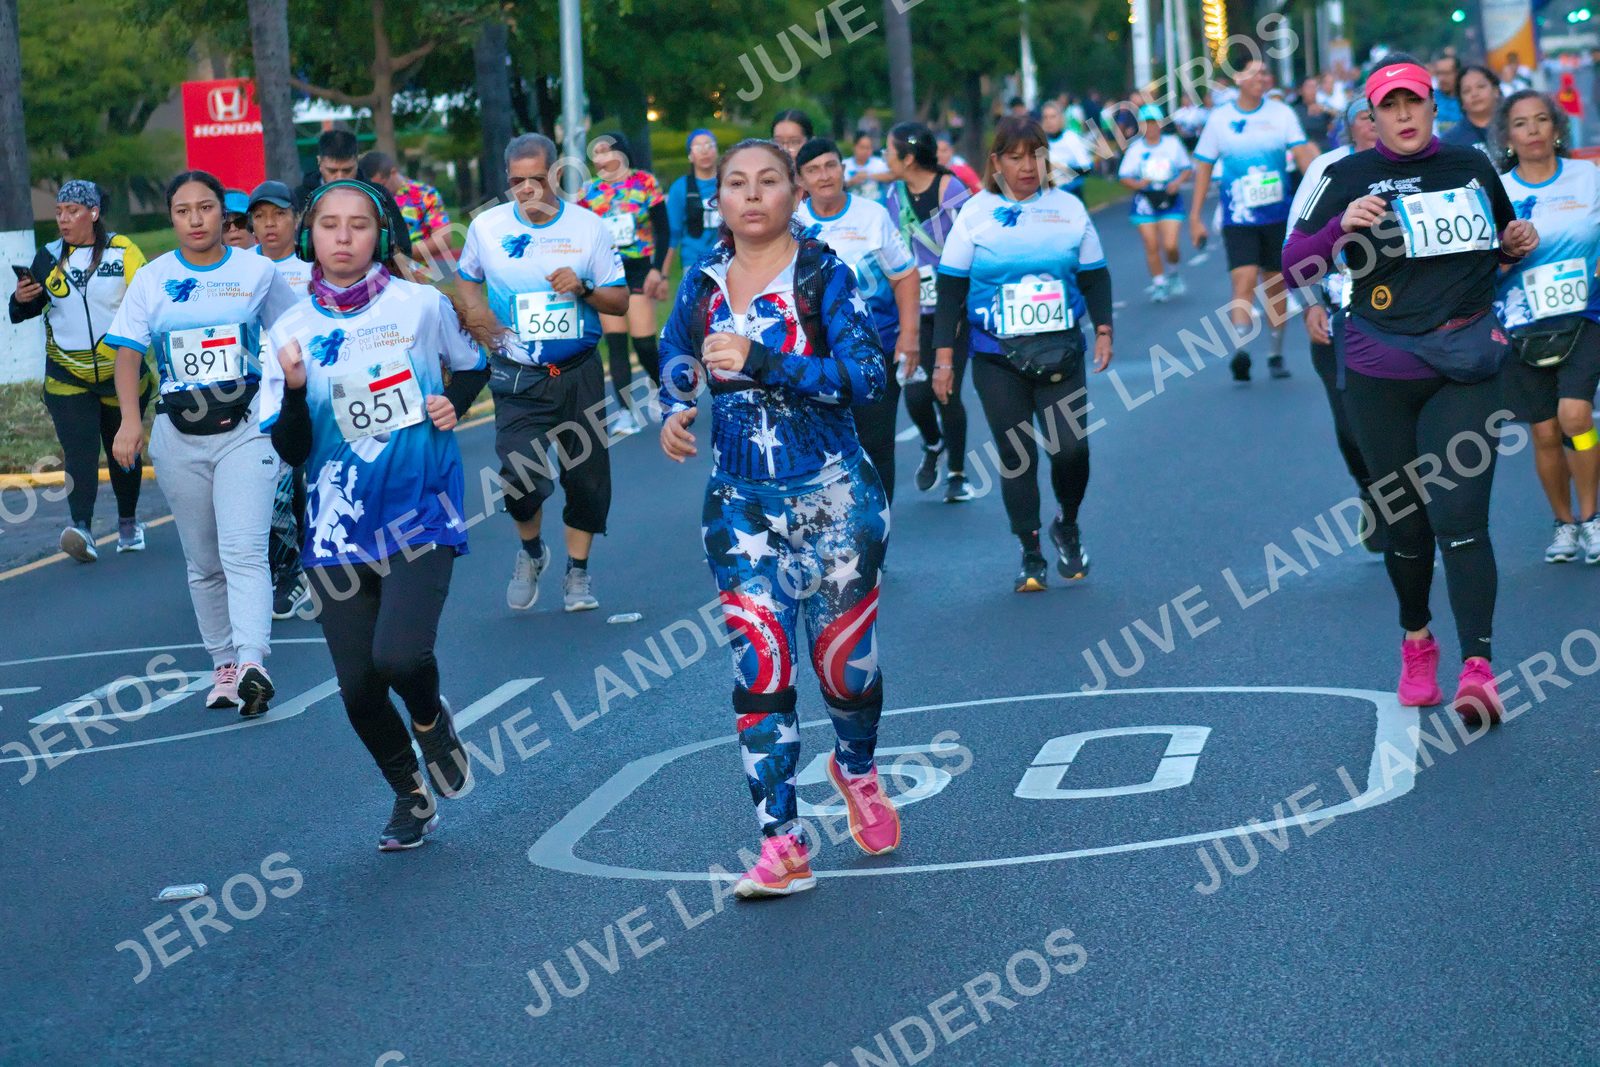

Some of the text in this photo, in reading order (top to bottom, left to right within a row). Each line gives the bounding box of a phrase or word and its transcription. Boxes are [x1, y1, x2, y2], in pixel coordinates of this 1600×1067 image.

[193, 121, 263, 138] HONDA
[1250, 186, 1279, 201] 884
[1416, 214, 1489, 247] 1802
[1530, 280, 1588, 312] 1880
[528, 312, 570, 335] 566
[1007, 303, 1064, 326] 1004
[356, 323, 398, 337] Carrera
[381, 330, 400, 339] Vida
[183, 348, 228, 377] 891
[348, 388, 409, 430] 851
